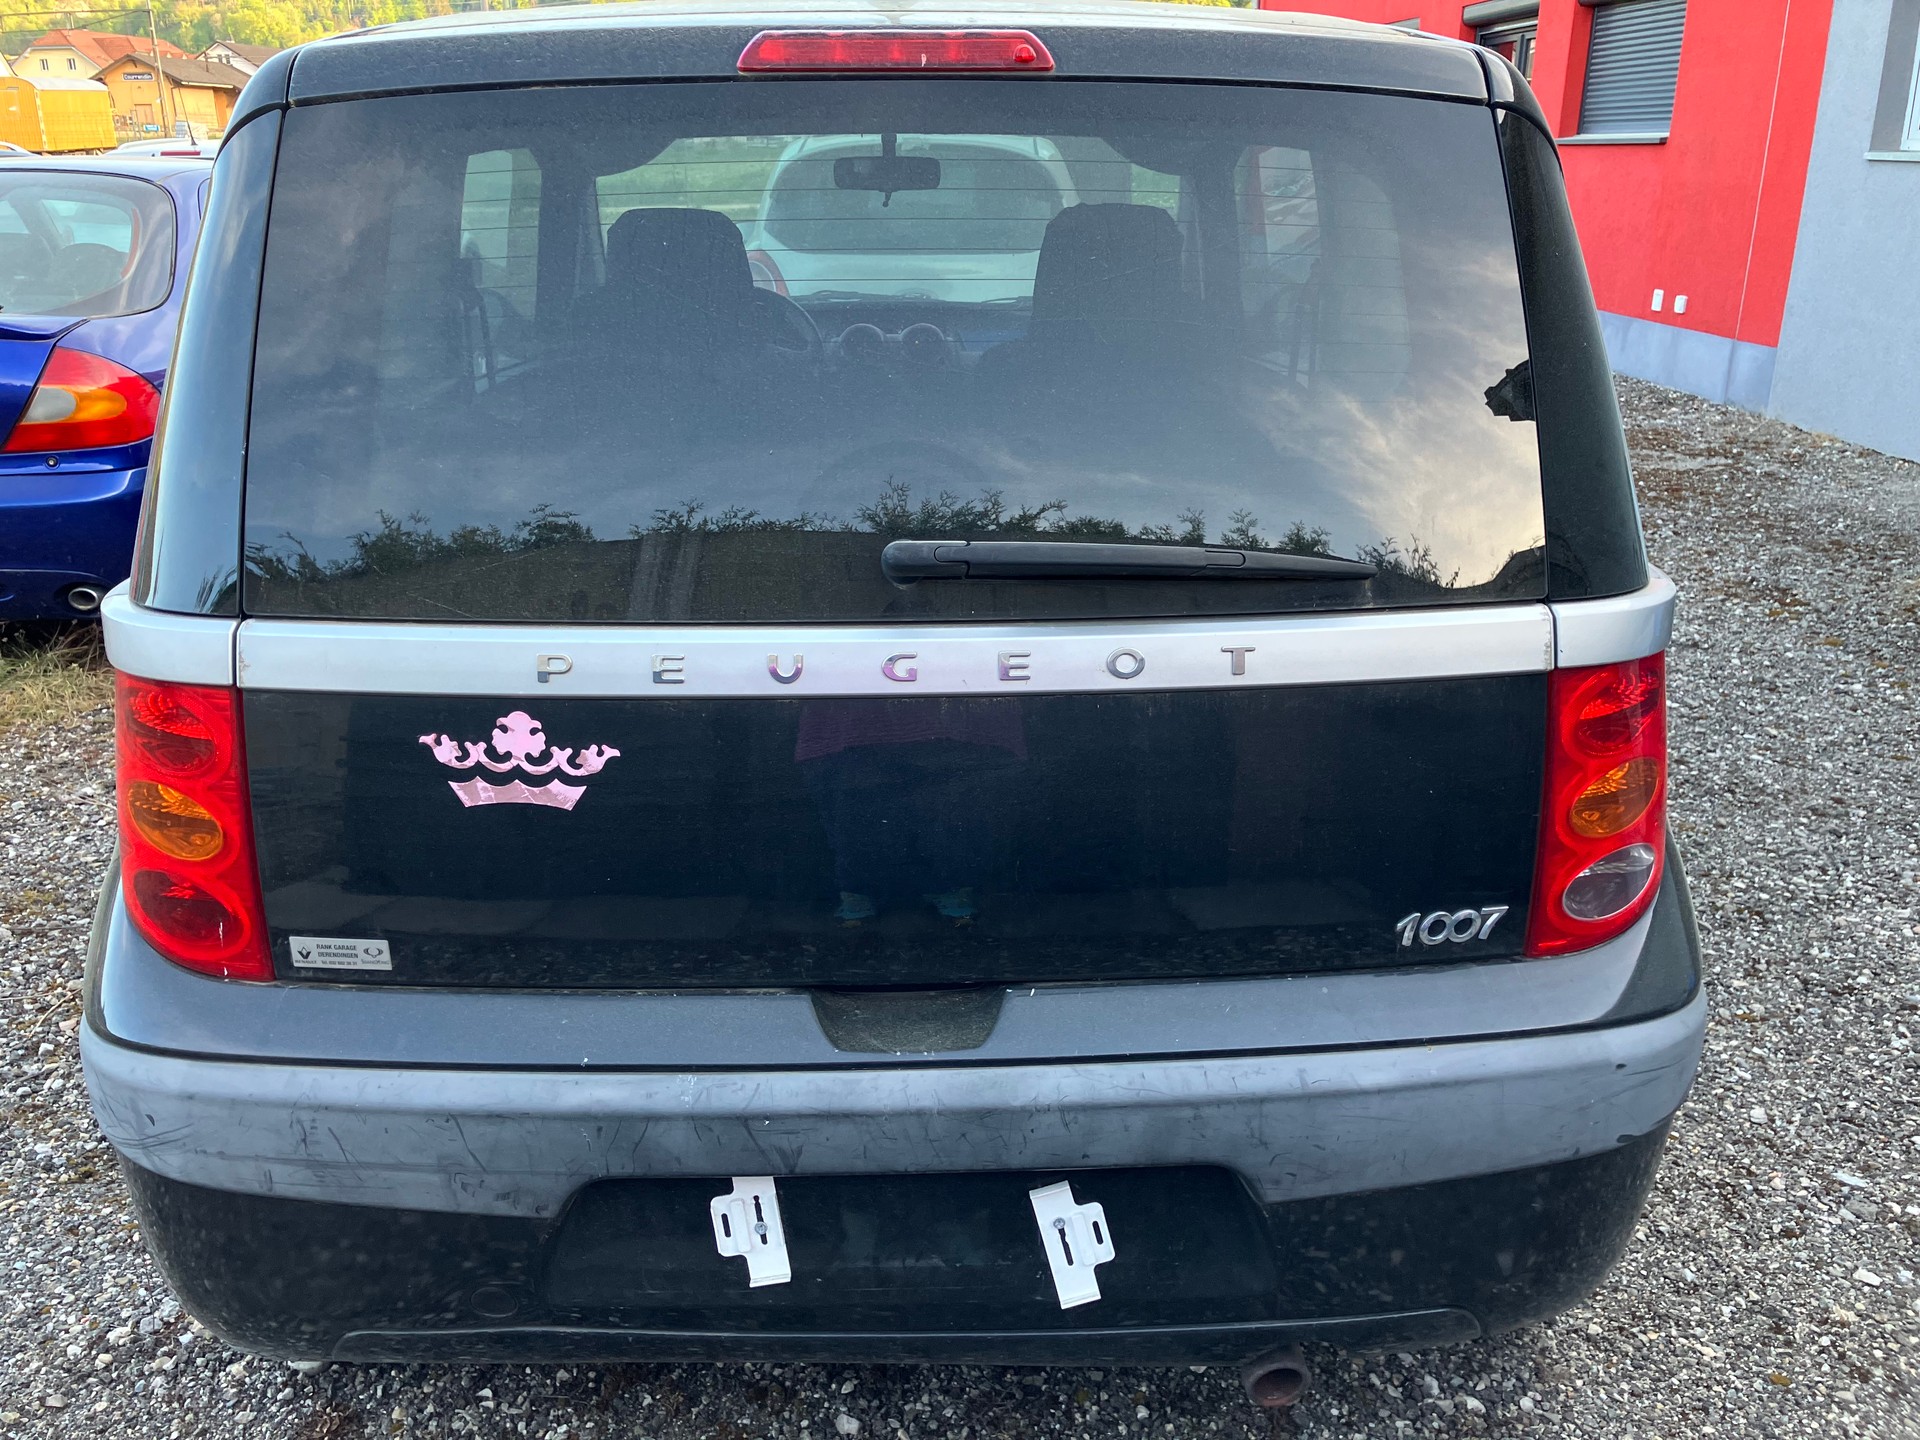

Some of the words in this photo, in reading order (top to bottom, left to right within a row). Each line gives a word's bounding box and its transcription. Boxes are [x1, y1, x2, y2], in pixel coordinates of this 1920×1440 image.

[537, 646, 1256, 683] PEUGEOT
[1396, 905, 1510, 947] 1007
[318, 951, 359, 959] DERENDINGEN
